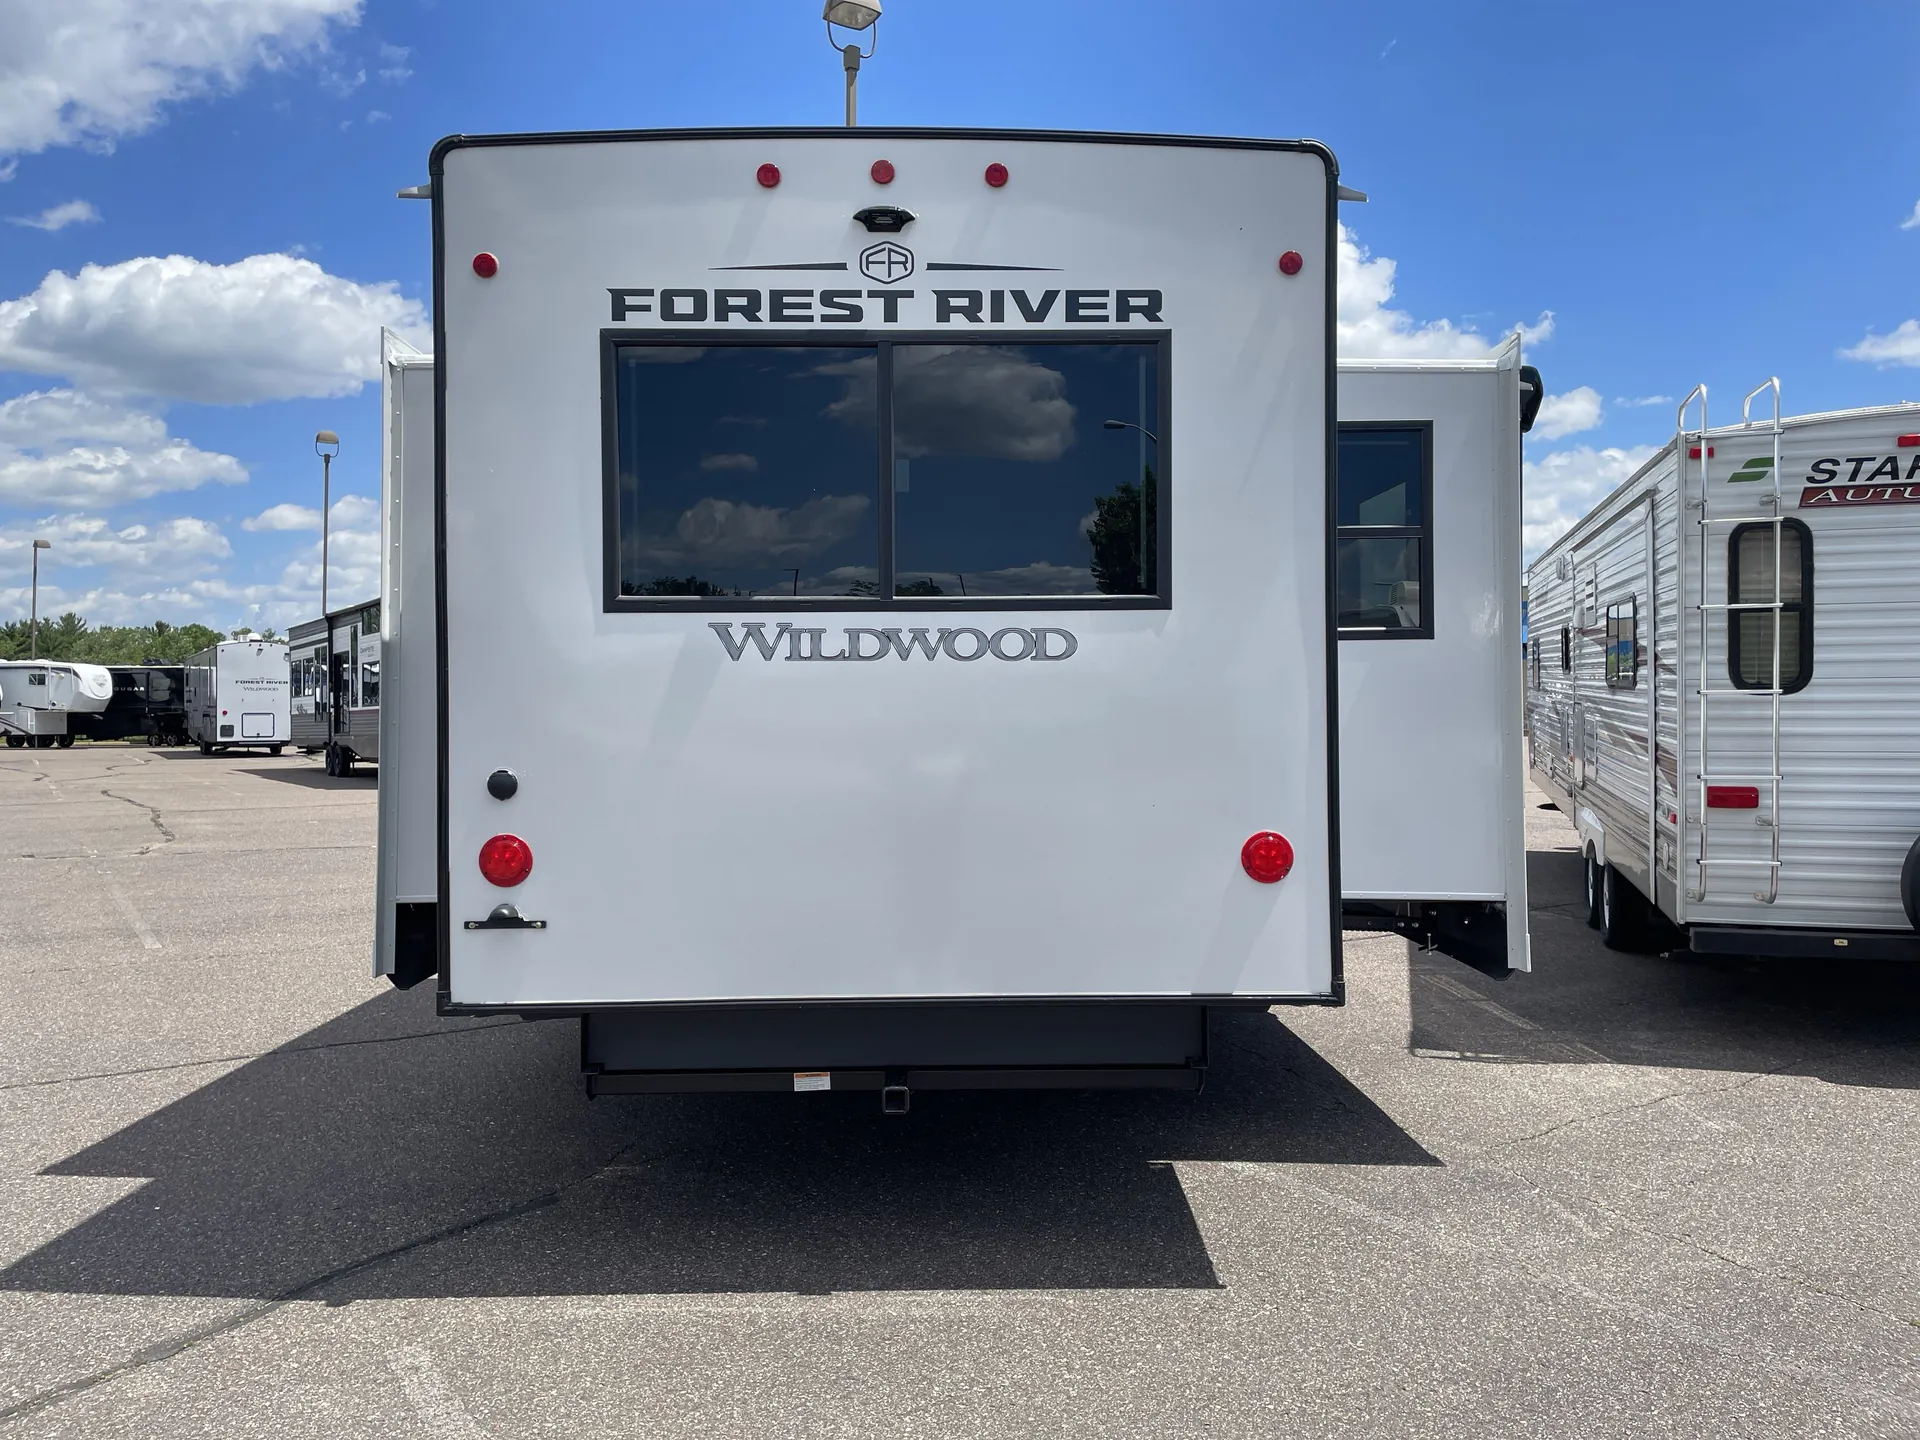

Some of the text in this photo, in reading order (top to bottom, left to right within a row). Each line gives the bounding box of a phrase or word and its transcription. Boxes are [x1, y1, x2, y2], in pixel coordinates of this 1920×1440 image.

[605, 287, 1164, 323] FOREST RIVER
[707, 622, 1079, 662] WILDWOOD
